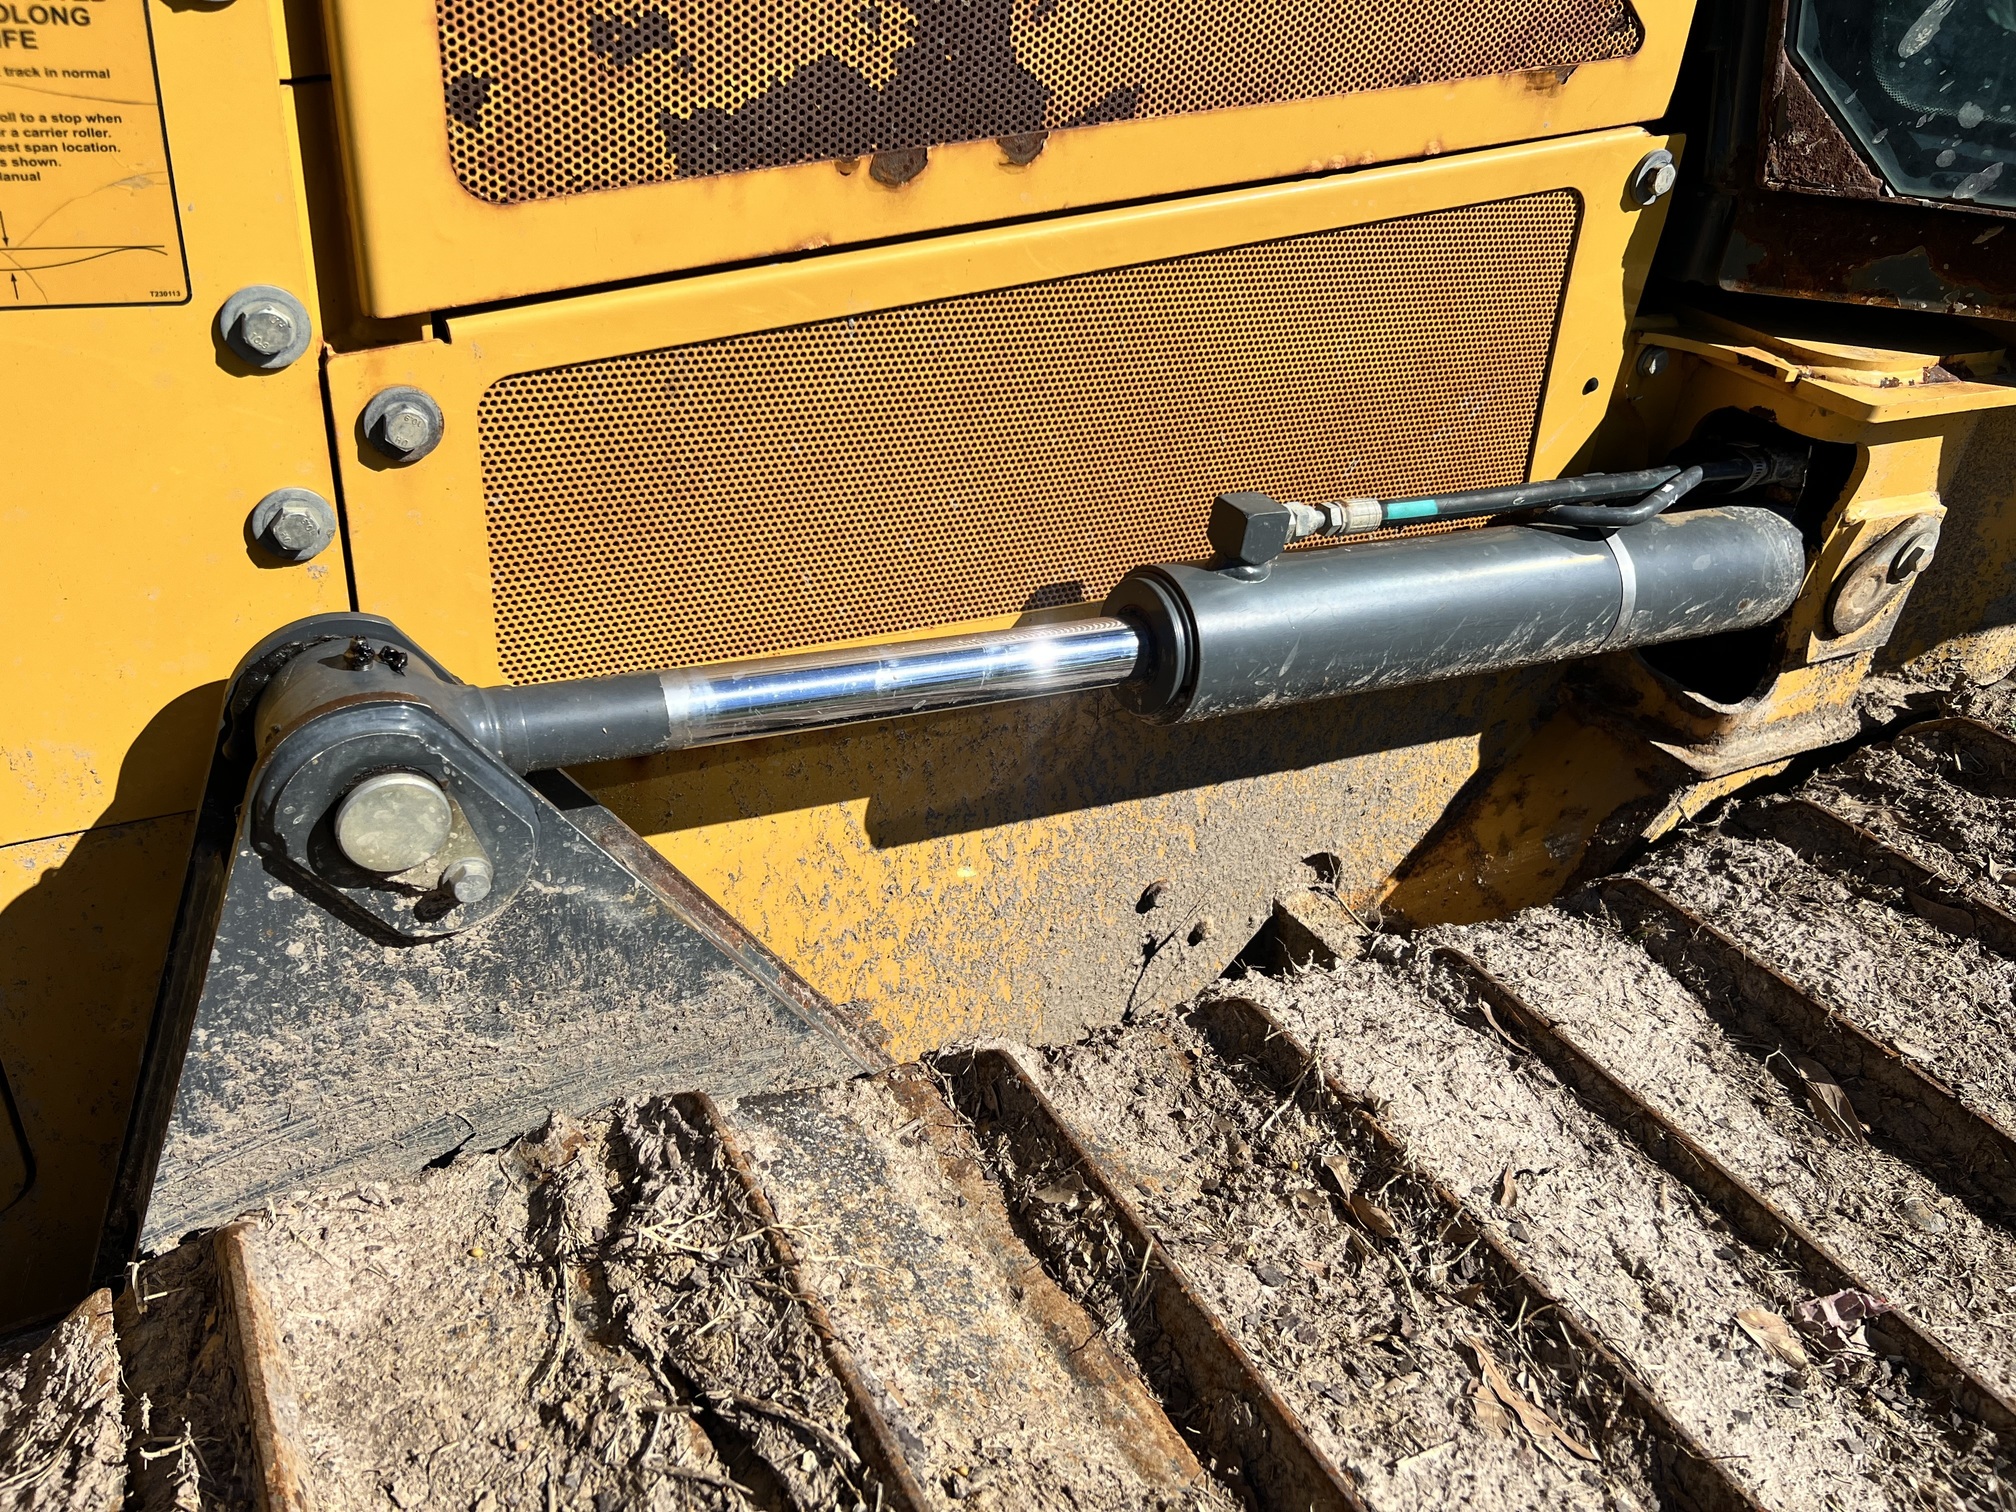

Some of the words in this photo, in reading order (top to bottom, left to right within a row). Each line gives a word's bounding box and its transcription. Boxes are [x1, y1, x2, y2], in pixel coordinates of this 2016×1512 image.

[3, 66, 41, 78] track
[44, 67, 58, 78] in
[62, 68, 111, 79] normal
[20, 113, 35, 123] to
[39, 115, 48, 123] a
[51, 114, 82, 125] stop
[86, 113, 122, 123] when
[11, 129, 20, 138] a
[23, 127, 68, 138] carrier
[73, 128, 112, 138] roller.
[24, 144, 59, 154] span
[62, 142, 121, 153] location.
[12, 157, 62, 168] shown.
[150, 290, 181, 298] T230113
